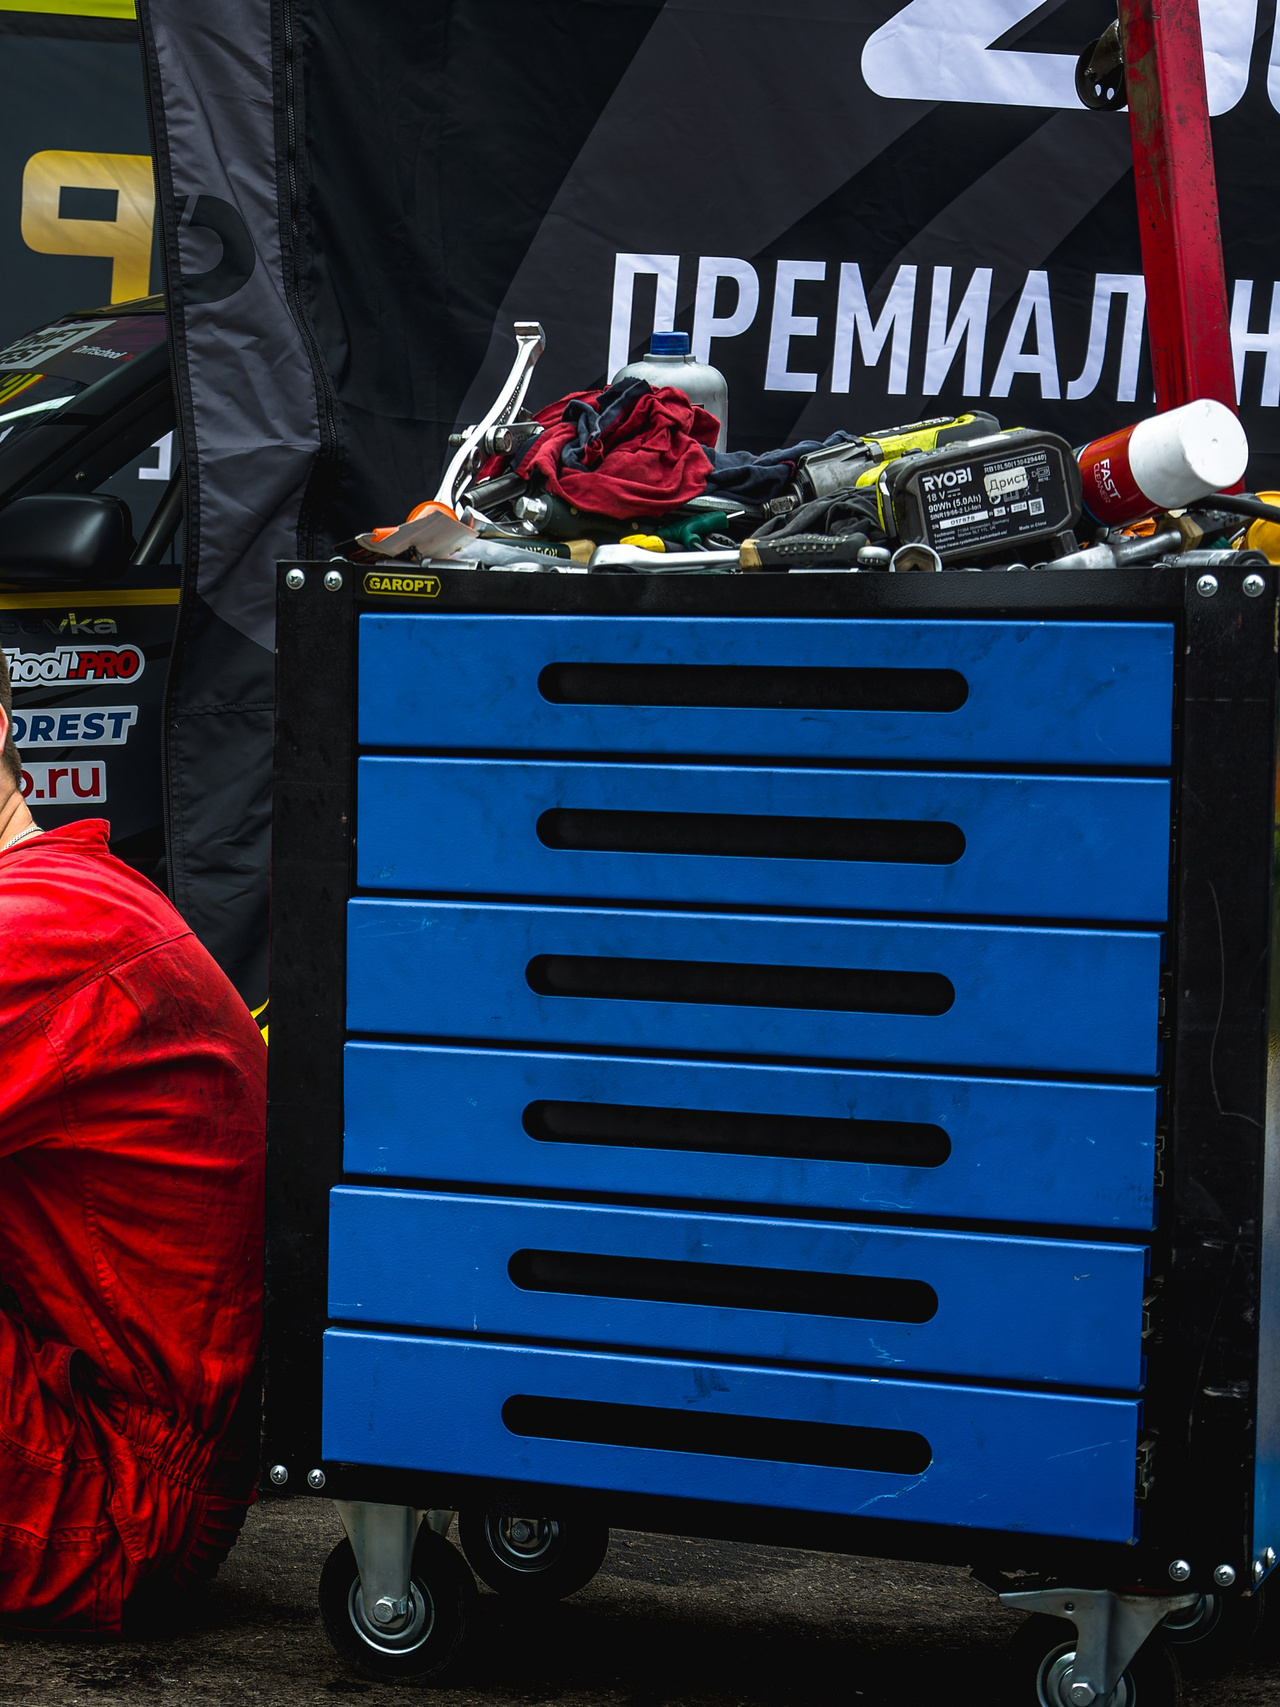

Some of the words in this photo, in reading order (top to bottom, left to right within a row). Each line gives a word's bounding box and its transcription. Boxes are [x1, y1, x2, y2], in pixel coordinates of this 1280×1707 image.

[608, 252, 1280, 407] ПРЕМИАЛН
[922, 467, 973, 492] RYOBI
[990, 473, 1026, 493] Дрист
[1093, 462, 1111, 504] CLEANER
[1100, 458, 1121, 499] FAST
[926, 493, 937, 503] 18
[928, 501, 951, 513] 90Wh
[952, 494, 982, 508] (5.0Ah)
[369, 577, 435, 593] GAROPT
[6, 651, 138, 680] hool.PRO
[12, 712, 132, 742] OREST
